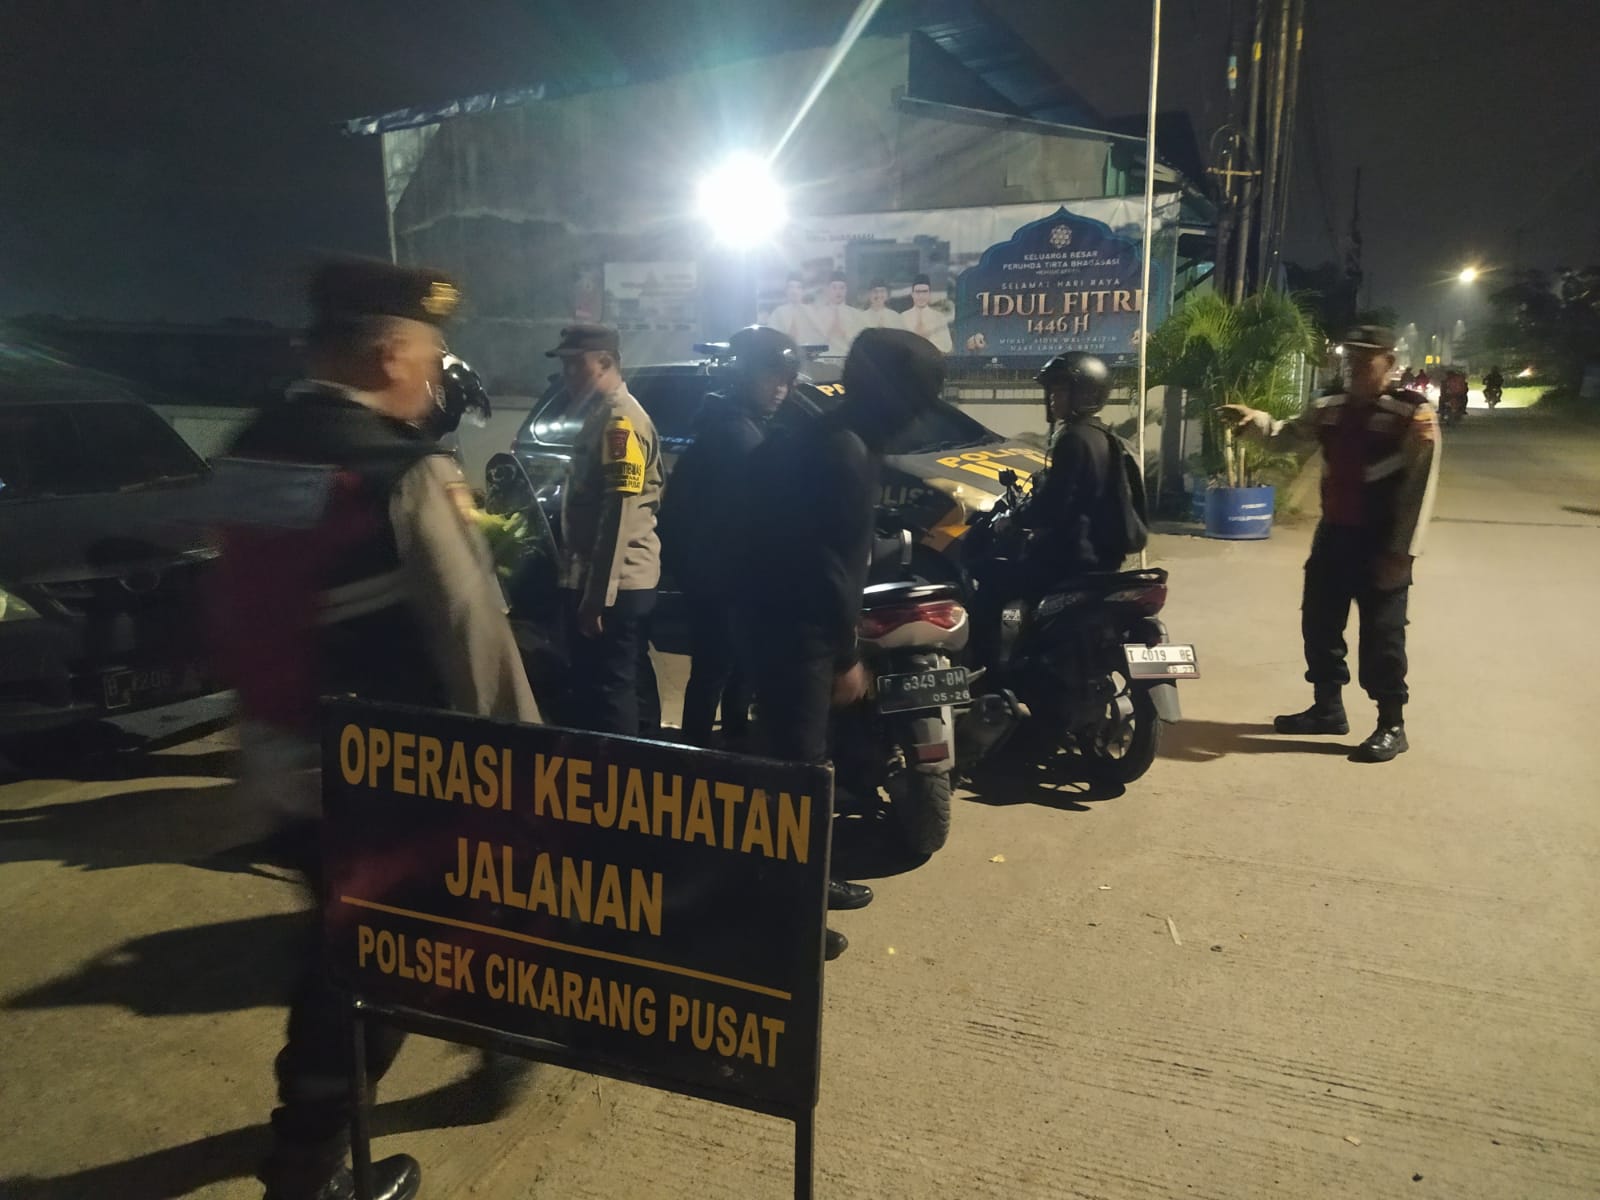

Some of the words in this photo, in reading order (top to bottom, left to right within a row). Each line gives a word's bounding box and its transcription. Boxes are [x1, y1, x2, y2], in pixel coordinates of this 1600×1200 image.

[1003, 262, 1042, 271] PERUMDA
[1045, 260, 1068, 269] TIRTA
[1023, 252, 1067, 261] KELUARGA
[1070, 250, 1098, 259] BESAR
[1001, 281, 1050, 290] SELAMAT
[1057, 279, 1084, 288] HARI
[1090, 278, 1120, 287] RAYA
[976, 291, 1054, 317] IDUL
[1063, 289, 1143, 316] FITRI
[1027, 316, 1068, 335] 1446
[1073, 313, 1089, 335] H
[1128, 650, 1134, 661] T
[339, 723, 513, 812] OPERASI
[533, 752, 812, 864] KEJAHATAN
[444, 836, 664, 937] JALANAN
[357, 925, 476, 994] POLSEK
[485, 953, 657, 1036] CIKARANG
[668, 993, 786, 1069] PUSAT
